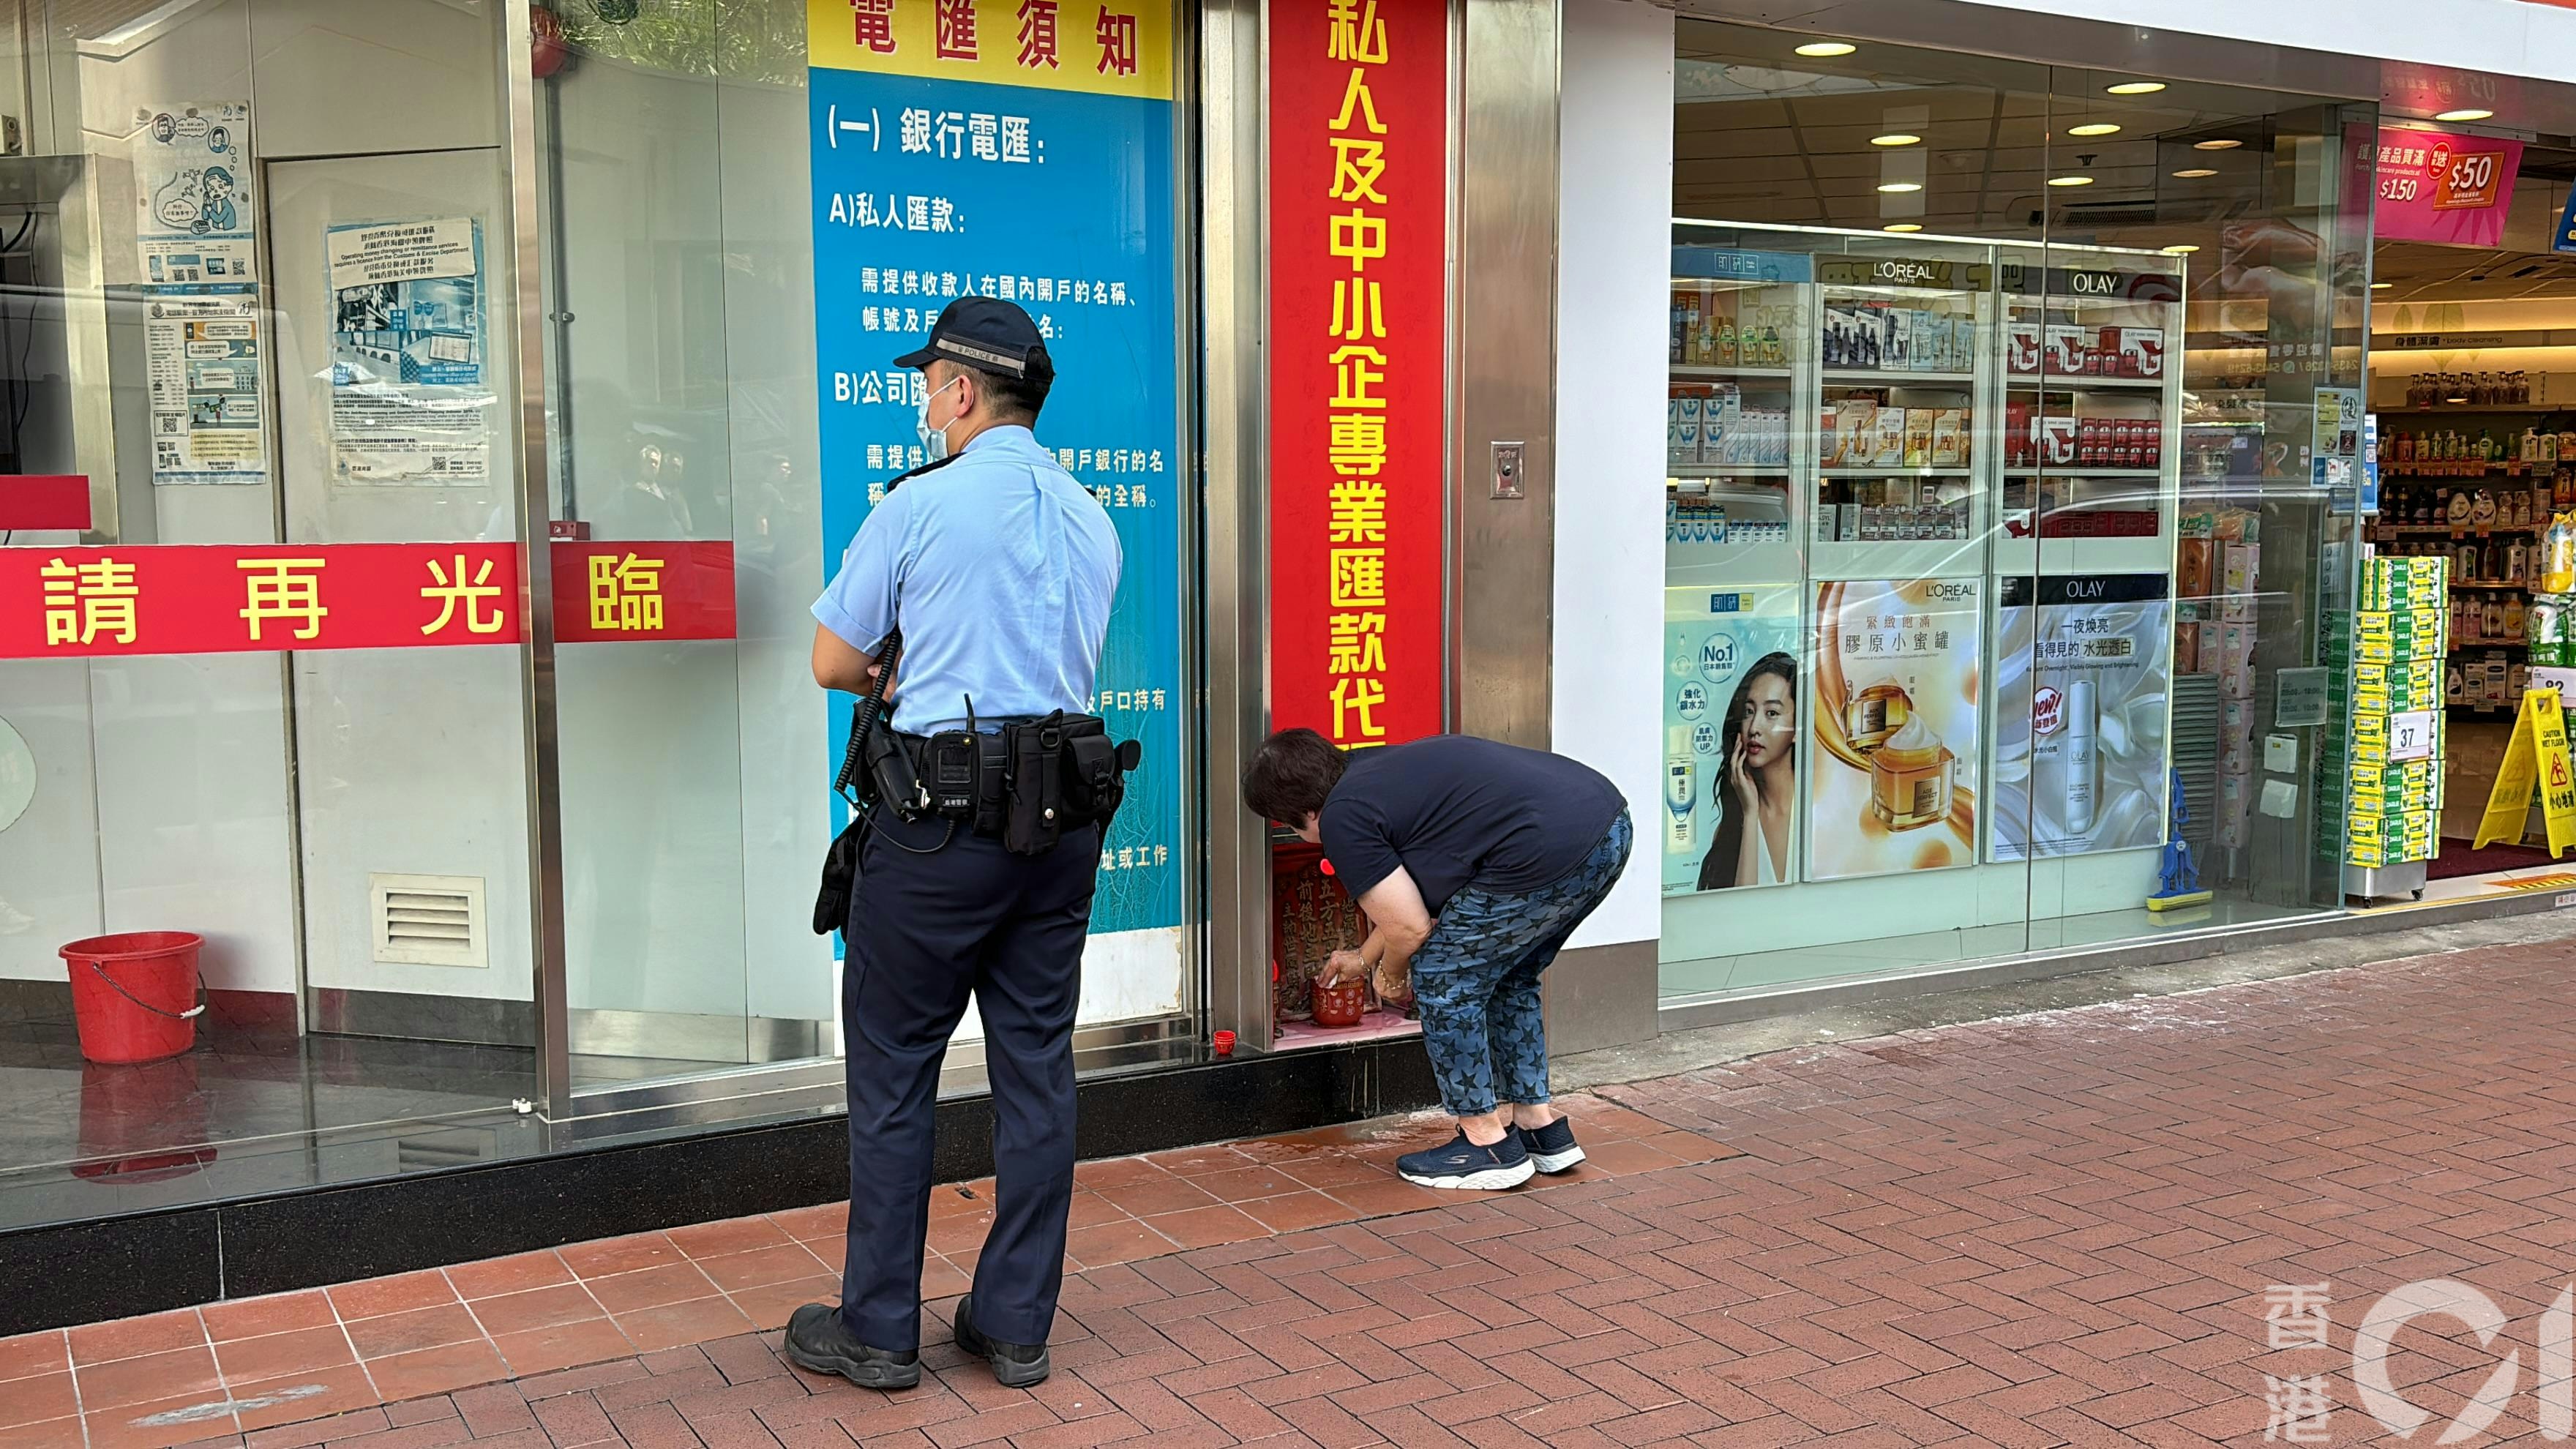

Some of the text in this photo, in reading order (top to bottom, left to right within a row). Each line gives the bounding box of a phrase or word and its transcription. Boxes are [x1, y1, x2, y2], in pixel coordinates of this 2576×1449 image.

[850, 0, 1139, 76] 電匯須知
[2356, 143, 2426, 167] 護產品買滿
[2449, 157, 2492, 190] $50
[2380, 178, 2417, 201] $150
[341, 252, 364, 261] Operating
[380, 248, 403, 256] changing
[440, 247, 469, 255] Department
[1873, 262, 1936, 280] L'ORÉAL
[2073, 273, 2118, 293] OLAY
[2467, 336, 2503, 344] cleansing
[964, 347, 991, 362] POLICE
[1328, 0, 1389, 752] 私人及中小企專業匯款代
[1925, 583, 1977, 597] L'ORÉAL
[2066, 580, 2106, 598] OLAY
[1845, 630, 1950, 654] 膠原小蜜罐
[1704, 643, 1734, 662] No.1
[1684, 688, 1701, 699] 強化
[2400, 728, 2415, 748] 37
[2542, 729, 2561, 739] CAUTION
[2542, 737, 2565, 748] WET FLOOR
[1699, 743, 1711, 751] UP
